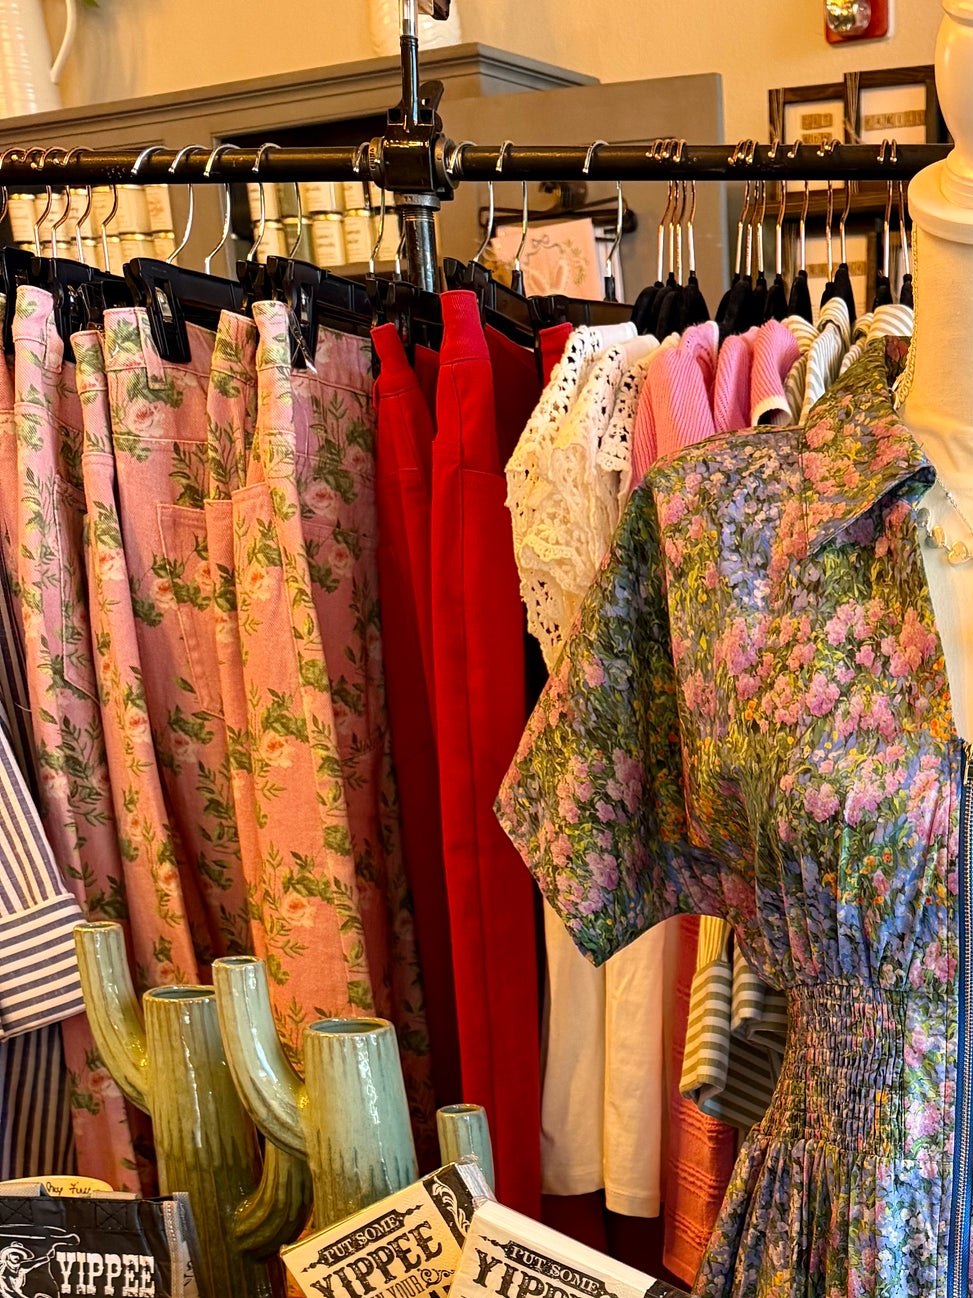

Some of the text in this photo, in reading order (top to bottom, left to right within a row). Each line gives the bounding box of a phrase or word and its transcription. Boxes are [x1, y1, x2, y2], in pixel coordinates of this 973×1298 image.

[324, 1213, 401, 1263] PUT SOME
[55, 1251, 156, 1298] YIPPEE
[511, 1245, 601, 1296] PUT SOME
